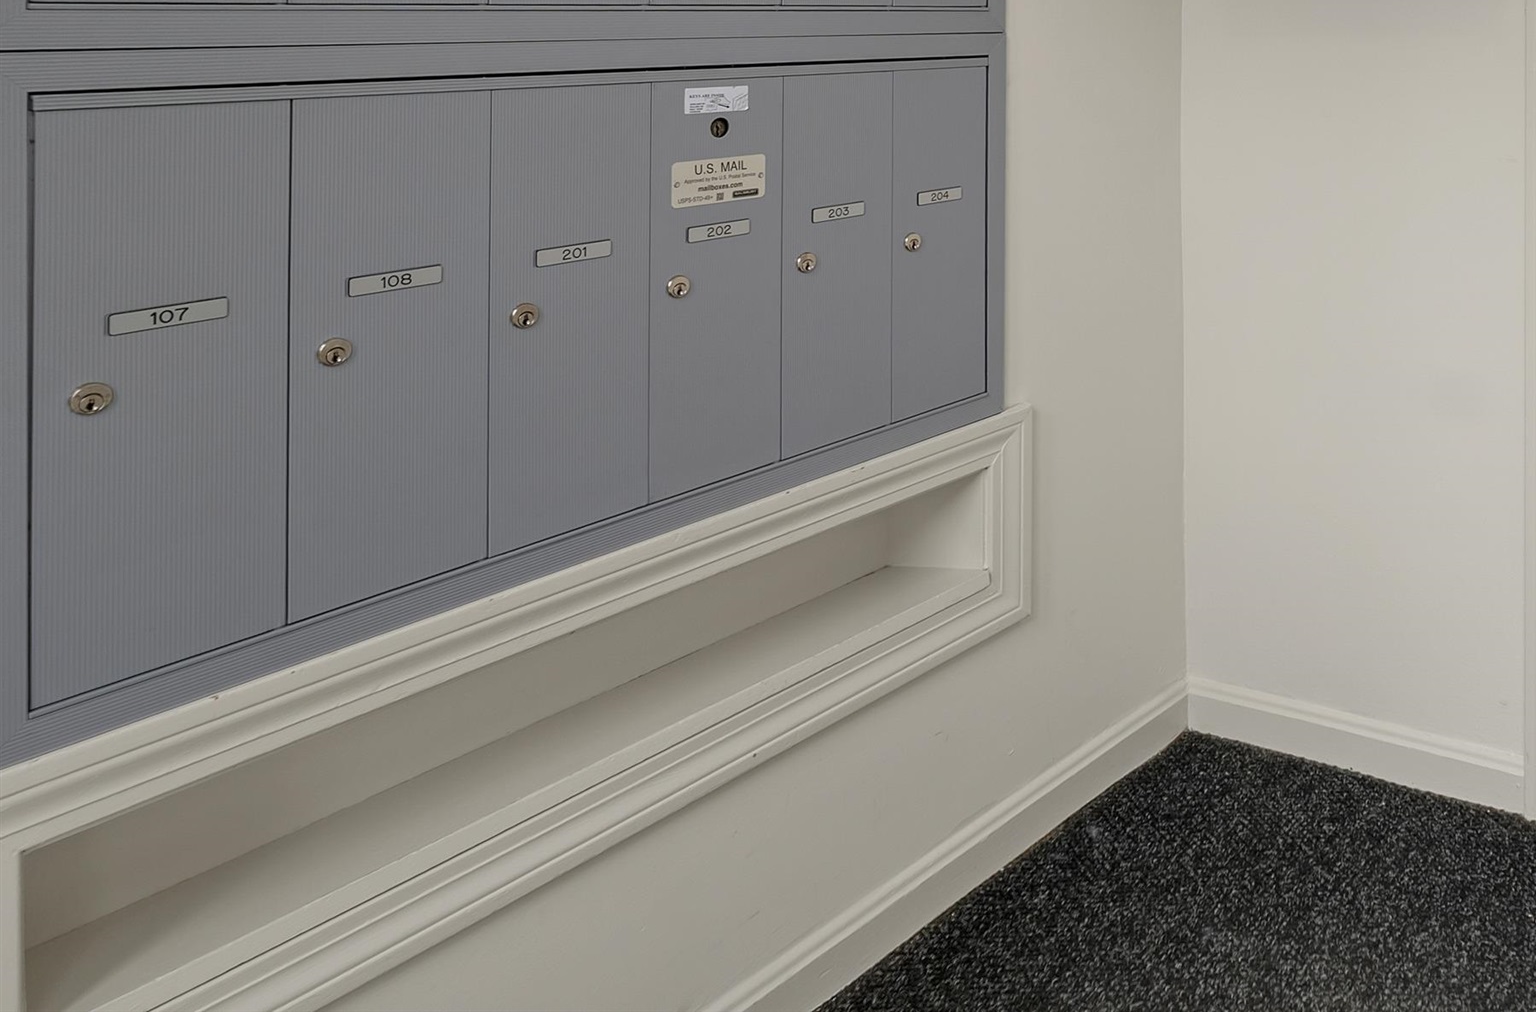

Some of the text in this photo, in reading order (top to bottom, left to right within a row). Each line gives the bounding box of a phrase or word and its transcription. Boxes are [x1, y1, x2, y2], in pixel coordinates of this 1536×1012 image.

[694, 160, 747, 175] U.S. MAIL
[698, 182, 743, 192] mailboxes.com
[931, 191, 949, 202] 204
[828, 206, 849, 218] 203
[707, 224, 732, 237] 202
[562, 247, 587, 260] 201
[381, 273, 412, 288] 108
[150, 308, 190, 326] 107
